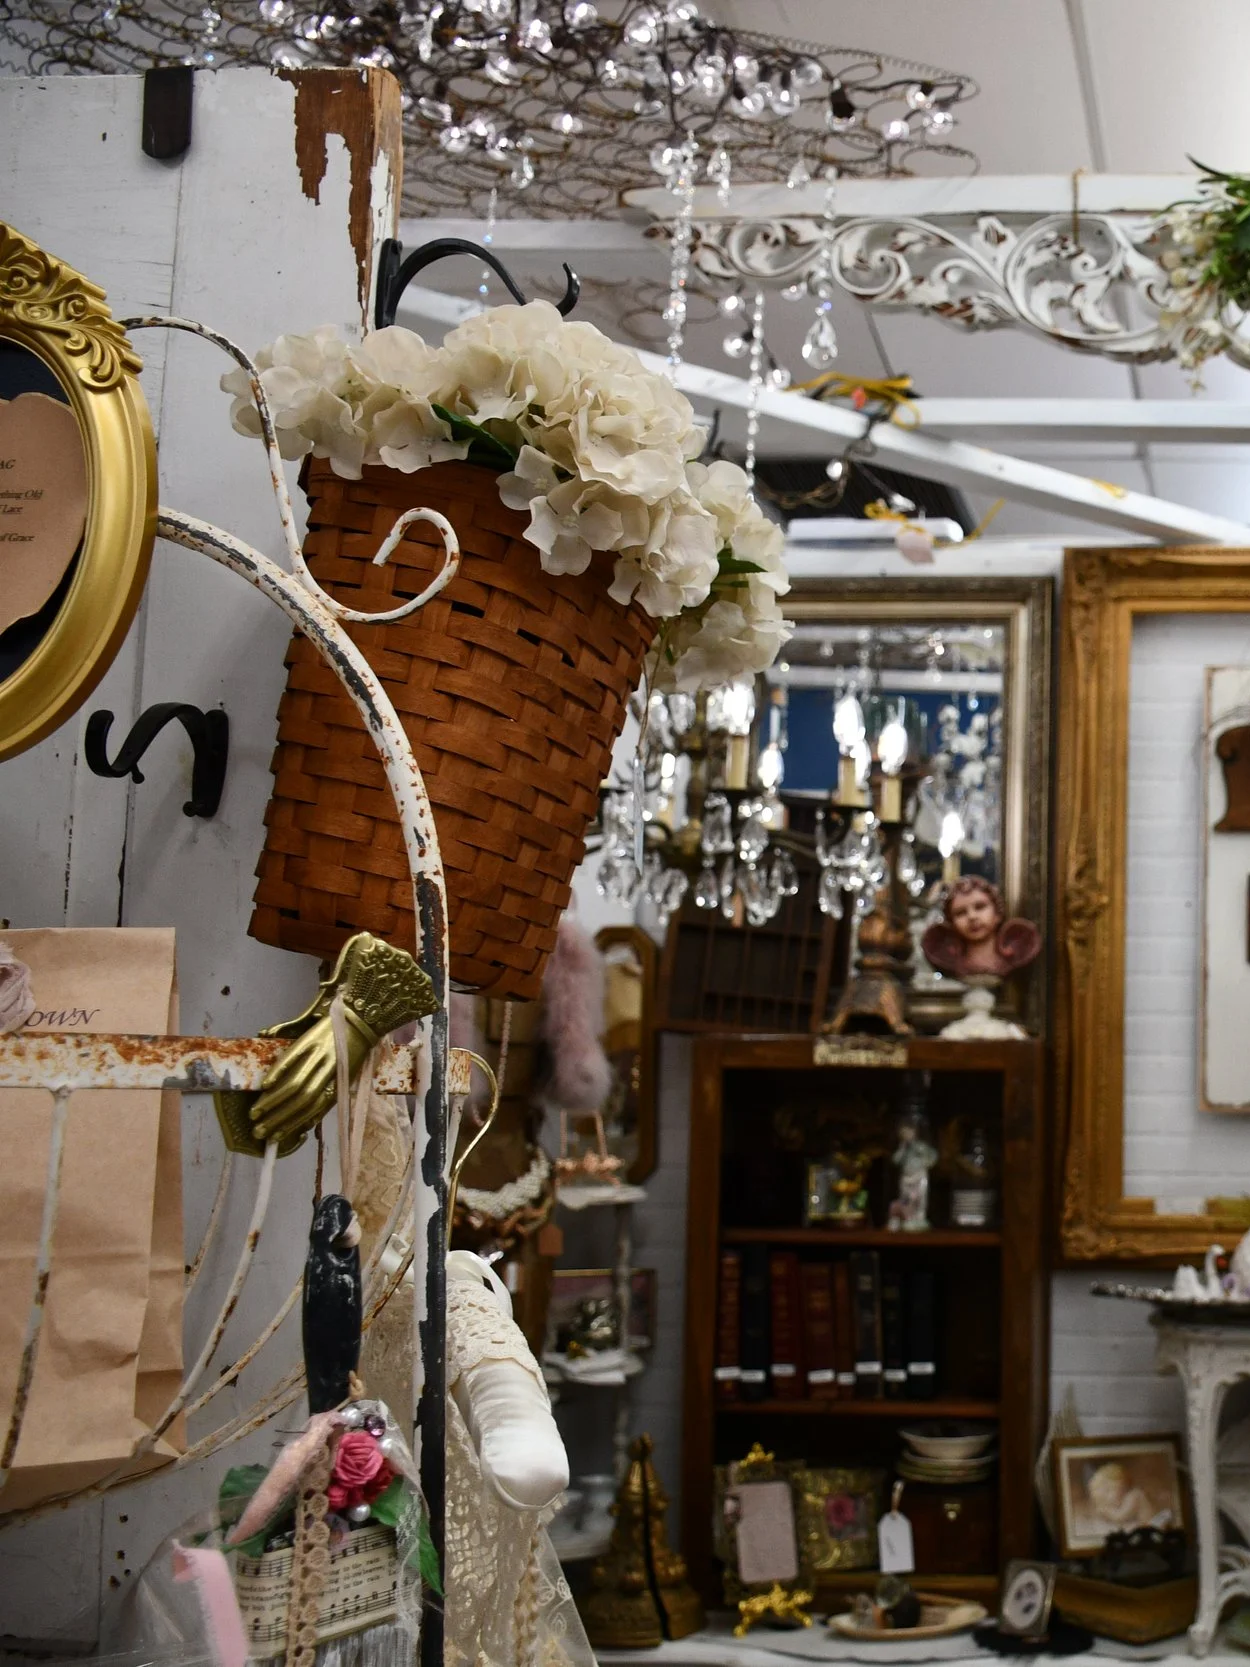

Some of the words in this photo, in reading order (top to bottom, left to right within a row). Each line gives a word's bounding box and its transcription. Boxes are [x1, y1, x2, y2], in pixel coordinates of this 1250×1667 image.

[24, 489, 43, 499] Old
[2, 504, 23, 513] Lace
[8, 533, 34, 541] Grace
[24, 1008, 101, 1027] OWN
